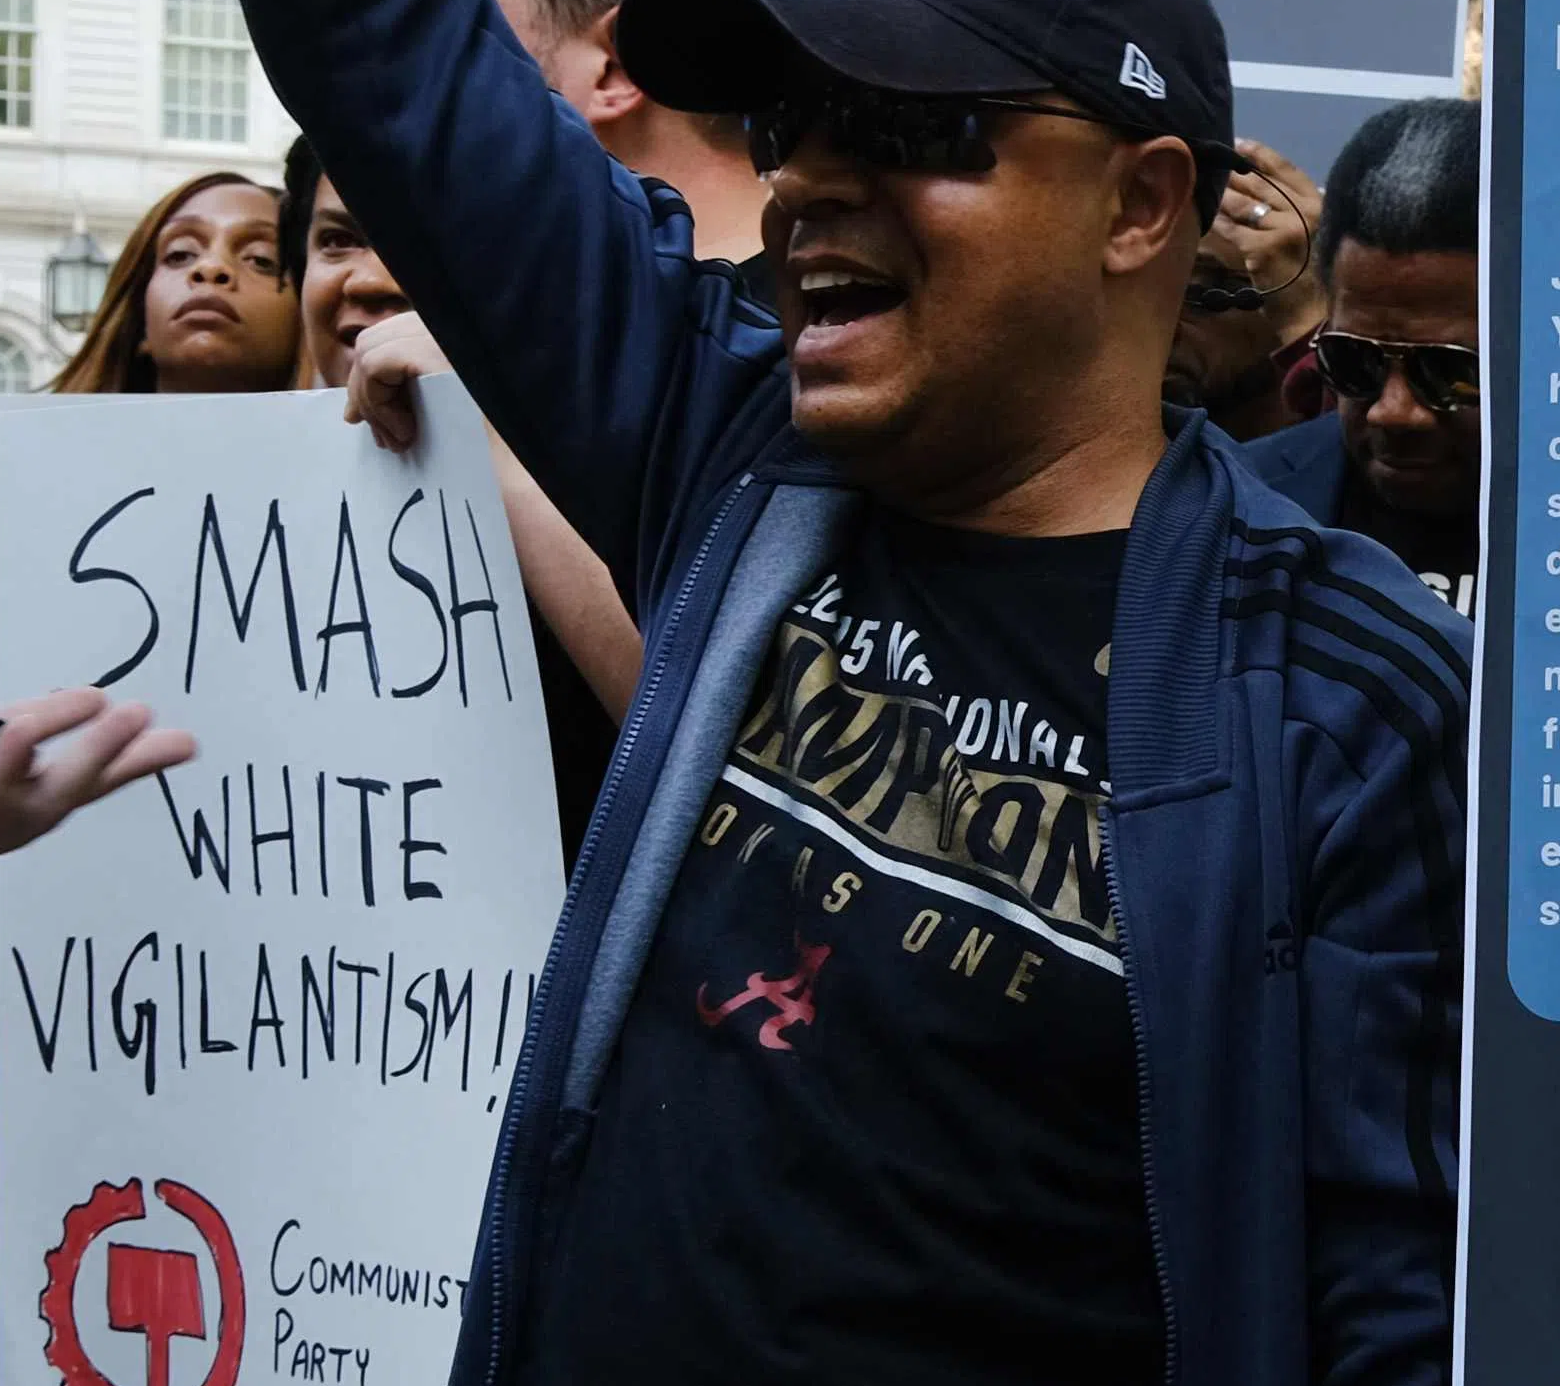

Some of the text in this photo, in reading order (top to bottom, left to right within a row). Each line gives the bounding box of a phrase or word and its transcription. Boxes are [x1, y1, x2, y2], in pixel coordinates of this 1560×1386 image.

[52, 487, 513, 709] SMASH
[885, 621, 1092, 778] NAIONAL
[156, 763, 448, 908] WHITE
[11, 931, 536, 1114] VIGILANTISM!
[900, 908, 1046, 1006] ONE
[270, 1218, 471, 1318] COMMUNIST
